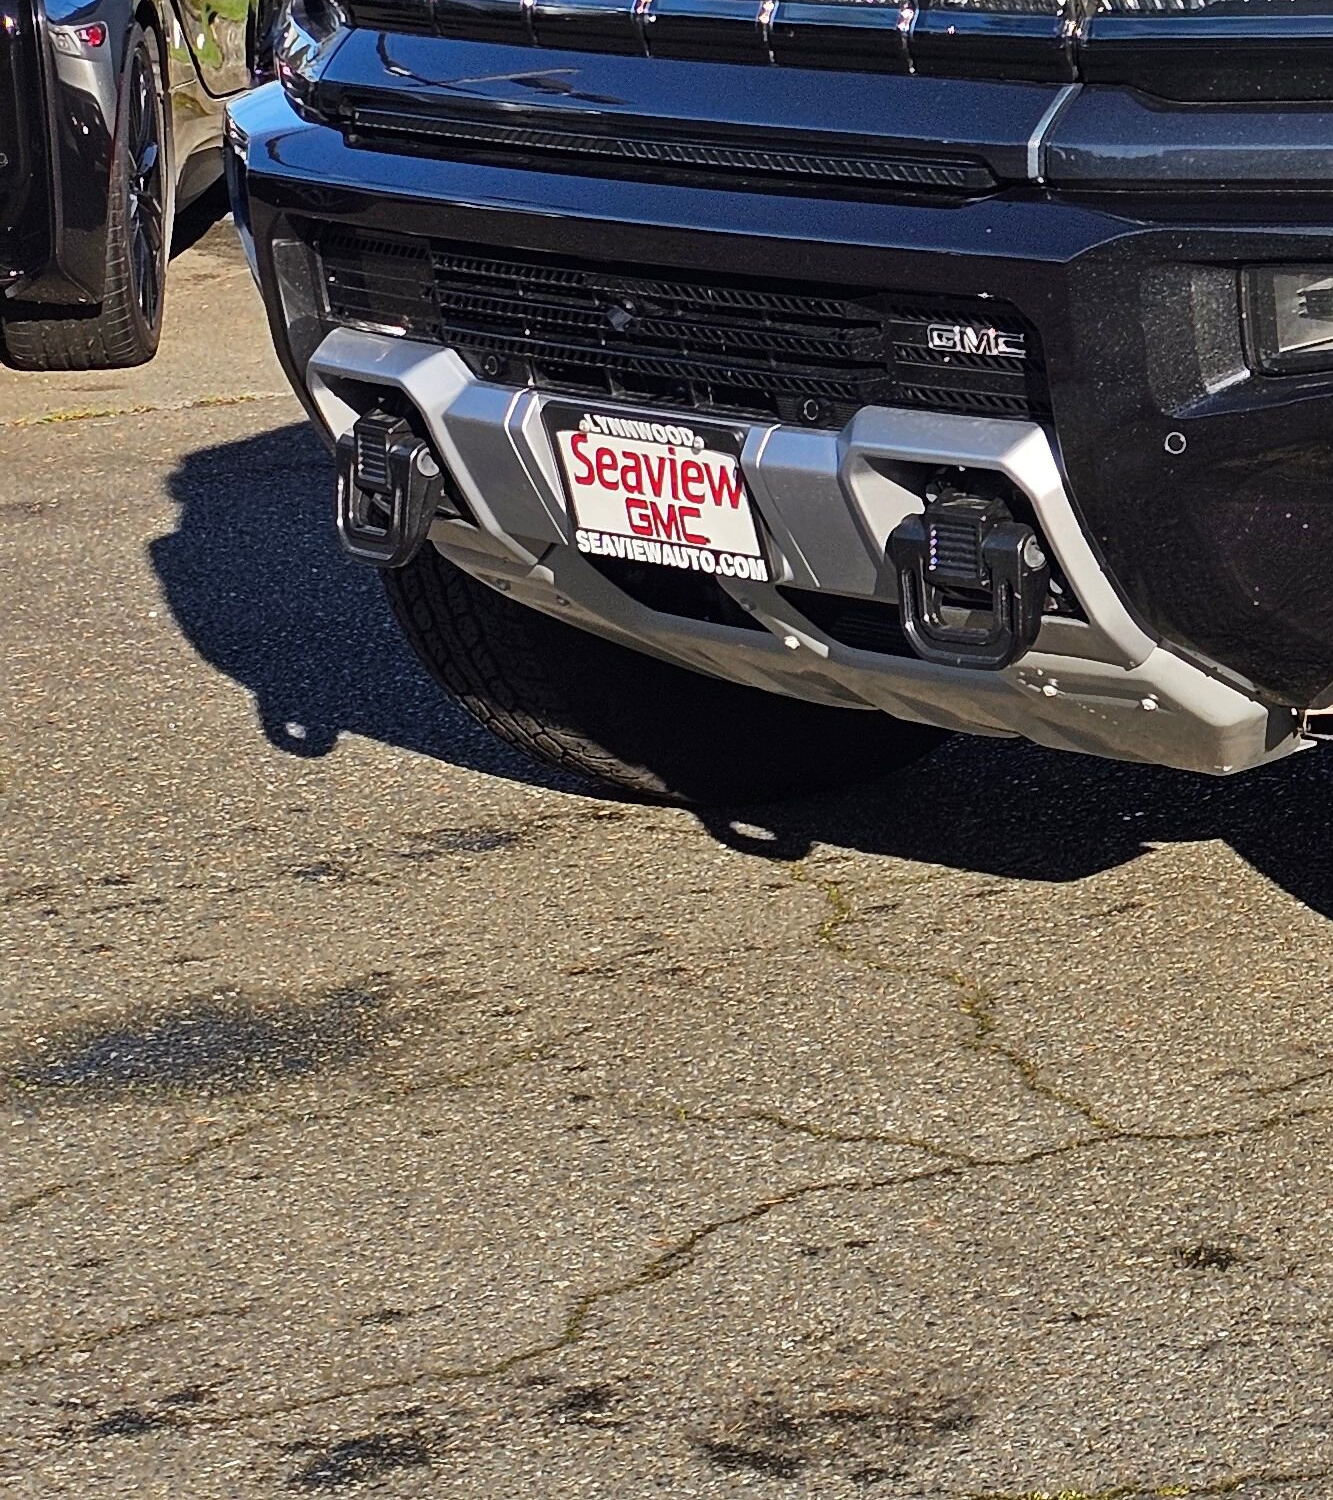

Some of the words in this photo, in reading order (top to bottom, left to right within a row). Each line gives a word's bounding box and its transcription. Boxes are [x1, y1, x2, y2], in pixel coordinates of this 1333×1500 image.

[926, 322, 1027, 358] GMC
[584, 413, 697, 449] LYNNWOOD
[569, 433, 743, 511] Seaview
[624, 496, 712, 546] GMC
[575, 529, 770, 582] SEAVIEWAUTO.COM
